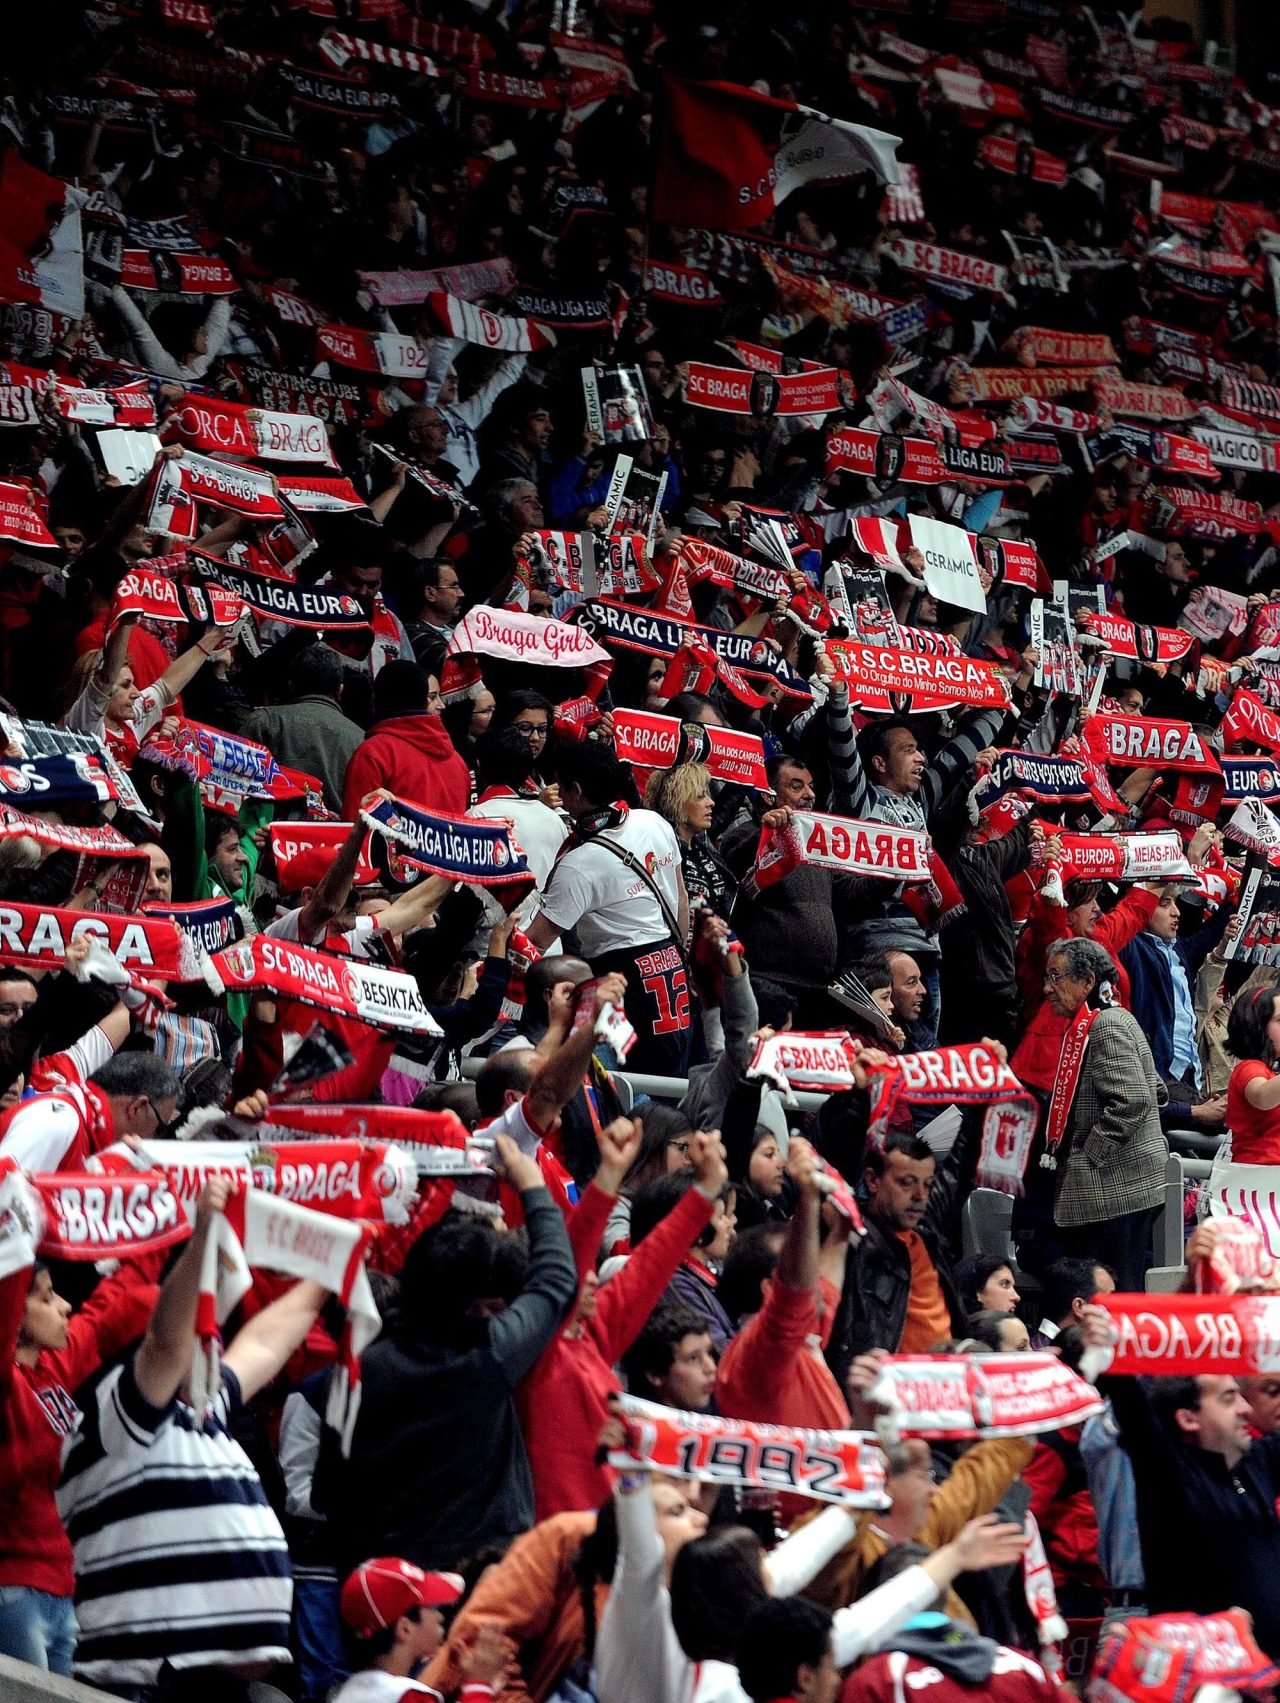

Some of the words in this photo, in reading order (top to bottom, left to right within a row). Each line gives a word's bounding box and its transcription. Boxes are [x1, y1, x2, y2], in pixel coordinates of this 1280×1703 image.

[937, 248, 996, 287] BRAGA
[708, 378, 747, 400] BRAGA
[178, 407, 247, 447] ORÇA
[949, 446, 979, 470] LIGA
[925, 549, 974, 578] CERAMIC
[117, 577, 176, 599] BRAGA
[258, 582, 298, 613] LIGA
[476, 611, 538, 657] Braga
[544, 621, 595, 661] Girls
[596, 604, 661, 643] BRAGA
[1101, 620, 1134, 642] BRAGA
[870, 670, 901, 687] Orgulho
[902, 675, 913, 688] do
[914, 677, 937, 692] Minho
[939, 681, 967, 696] Somos
[615, 723, 632, 748] SC
[633, 728, 676, 755] BRAGA
[712, 744, 726, 758] LIGA
[727, 747, 739, 759] DOS
[1112, 722, 1205, 762] BRAGA
[444, 834, 470, 864] LIGA
[1074, 848, 1115, 865] EUROPA
[261, 942, 288, 972] SC
[289, 950, 339, 993] BRAGA
[643, 969, 691, 1035] 12
[791, 1046, 848, 1071] BRAGA
[903, 1047, 1022, 1089] BRAGA
[279, 1161, 360, 1201] BRAGA
[60, 1182, 177, 1243] BRAGA
[678, 1439, 844, 1496] 1992
